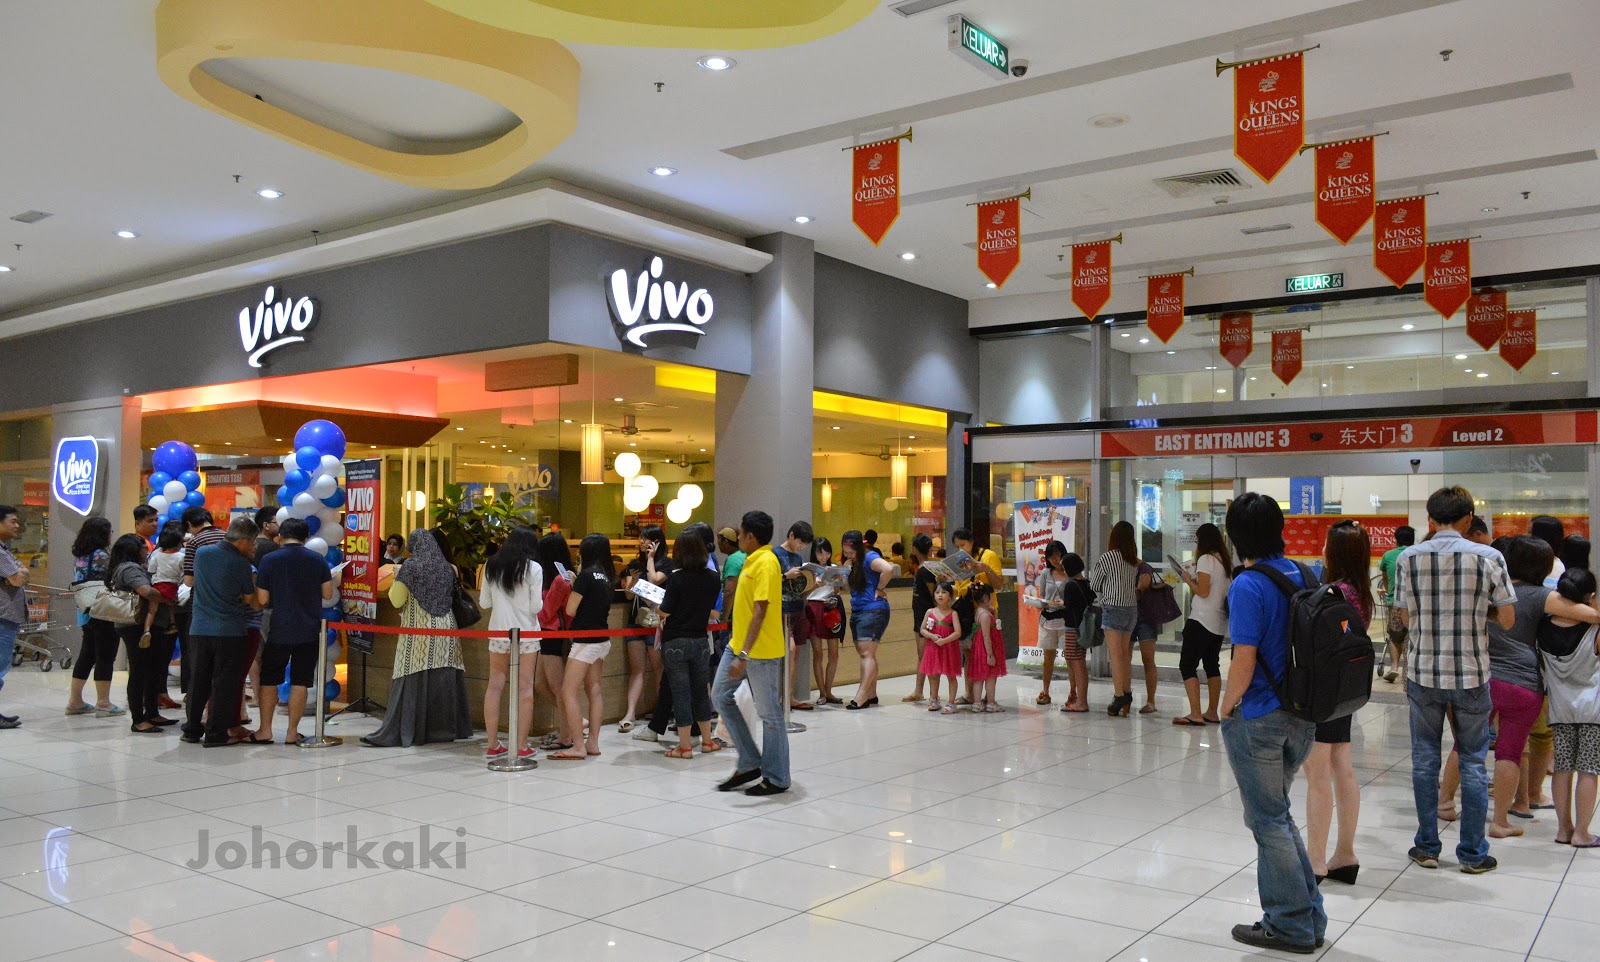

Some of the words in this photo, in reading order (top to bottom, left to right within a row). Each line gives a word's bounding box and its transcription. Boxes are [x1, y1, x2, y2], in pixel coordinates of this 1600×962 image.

[963, 22, 999, 66] KELUAR
[1250, 95, 1297, 115] KINGS
[1239, 110, 1300, 131] QUEENS
[862, 174, 894, 189] KINGS
[1328, 172, 1369, 188] KINGS
[855, 184, 896, 202] QUEENS
[1320, 184, 1371, 202] QUEENS
[986, 228, 1016, 240] KINGS
[1384, 227, 1421, 240] KINGS
[980, 238, 1018, 251] QUEENS
[1377, 236, 1423, 251] QUEENS
[1080, 266, 1107, 277] KINGS
[1433, 265, 1466, 277] KINGS
[1074, 275, 1109, 287] QUEENS
[1287, 275, 1331, 291] KELUAR
[1426, 274, 1468, 287] QUEENS
[1154, 296, 1180, 305] KINGS
[1149, 304, 1181, 315] QUEENS
[1474, 304, 1504, 314] KINGS
[1469, 312, 1505, 323] QUEENS
[1221, 333, 1251, 343] QUEENS
[1226, 327, 1250, 336] KINGS
[1506, 329, 1534, 339] KINGS
[1501, 336, 1535, 346] QUEENS
[1273, 353, 1301, 362] QUEENS
[1277, 347, 1299, 356] KINGS
[1155, 434, 1192, 451] EAST
[1194, 431, 1274, 450] ENTRANCE
[1278, 429, 1290, 448] 3
[1339, 426, 1396, 445] 东大门
[1400, 423, 1413, 443] 3
[1452, 430, 1492, 443] Level
[1494, 428, 1503, 442] 2
[348, 487, 374, 511] VIVO
[359, 512, 371, 531] DAY
[1019, 532, 1031, 542] Kids
[1032, 528, 1053, 538] Indoor
[1020, 536, 1054, 550] Playground
